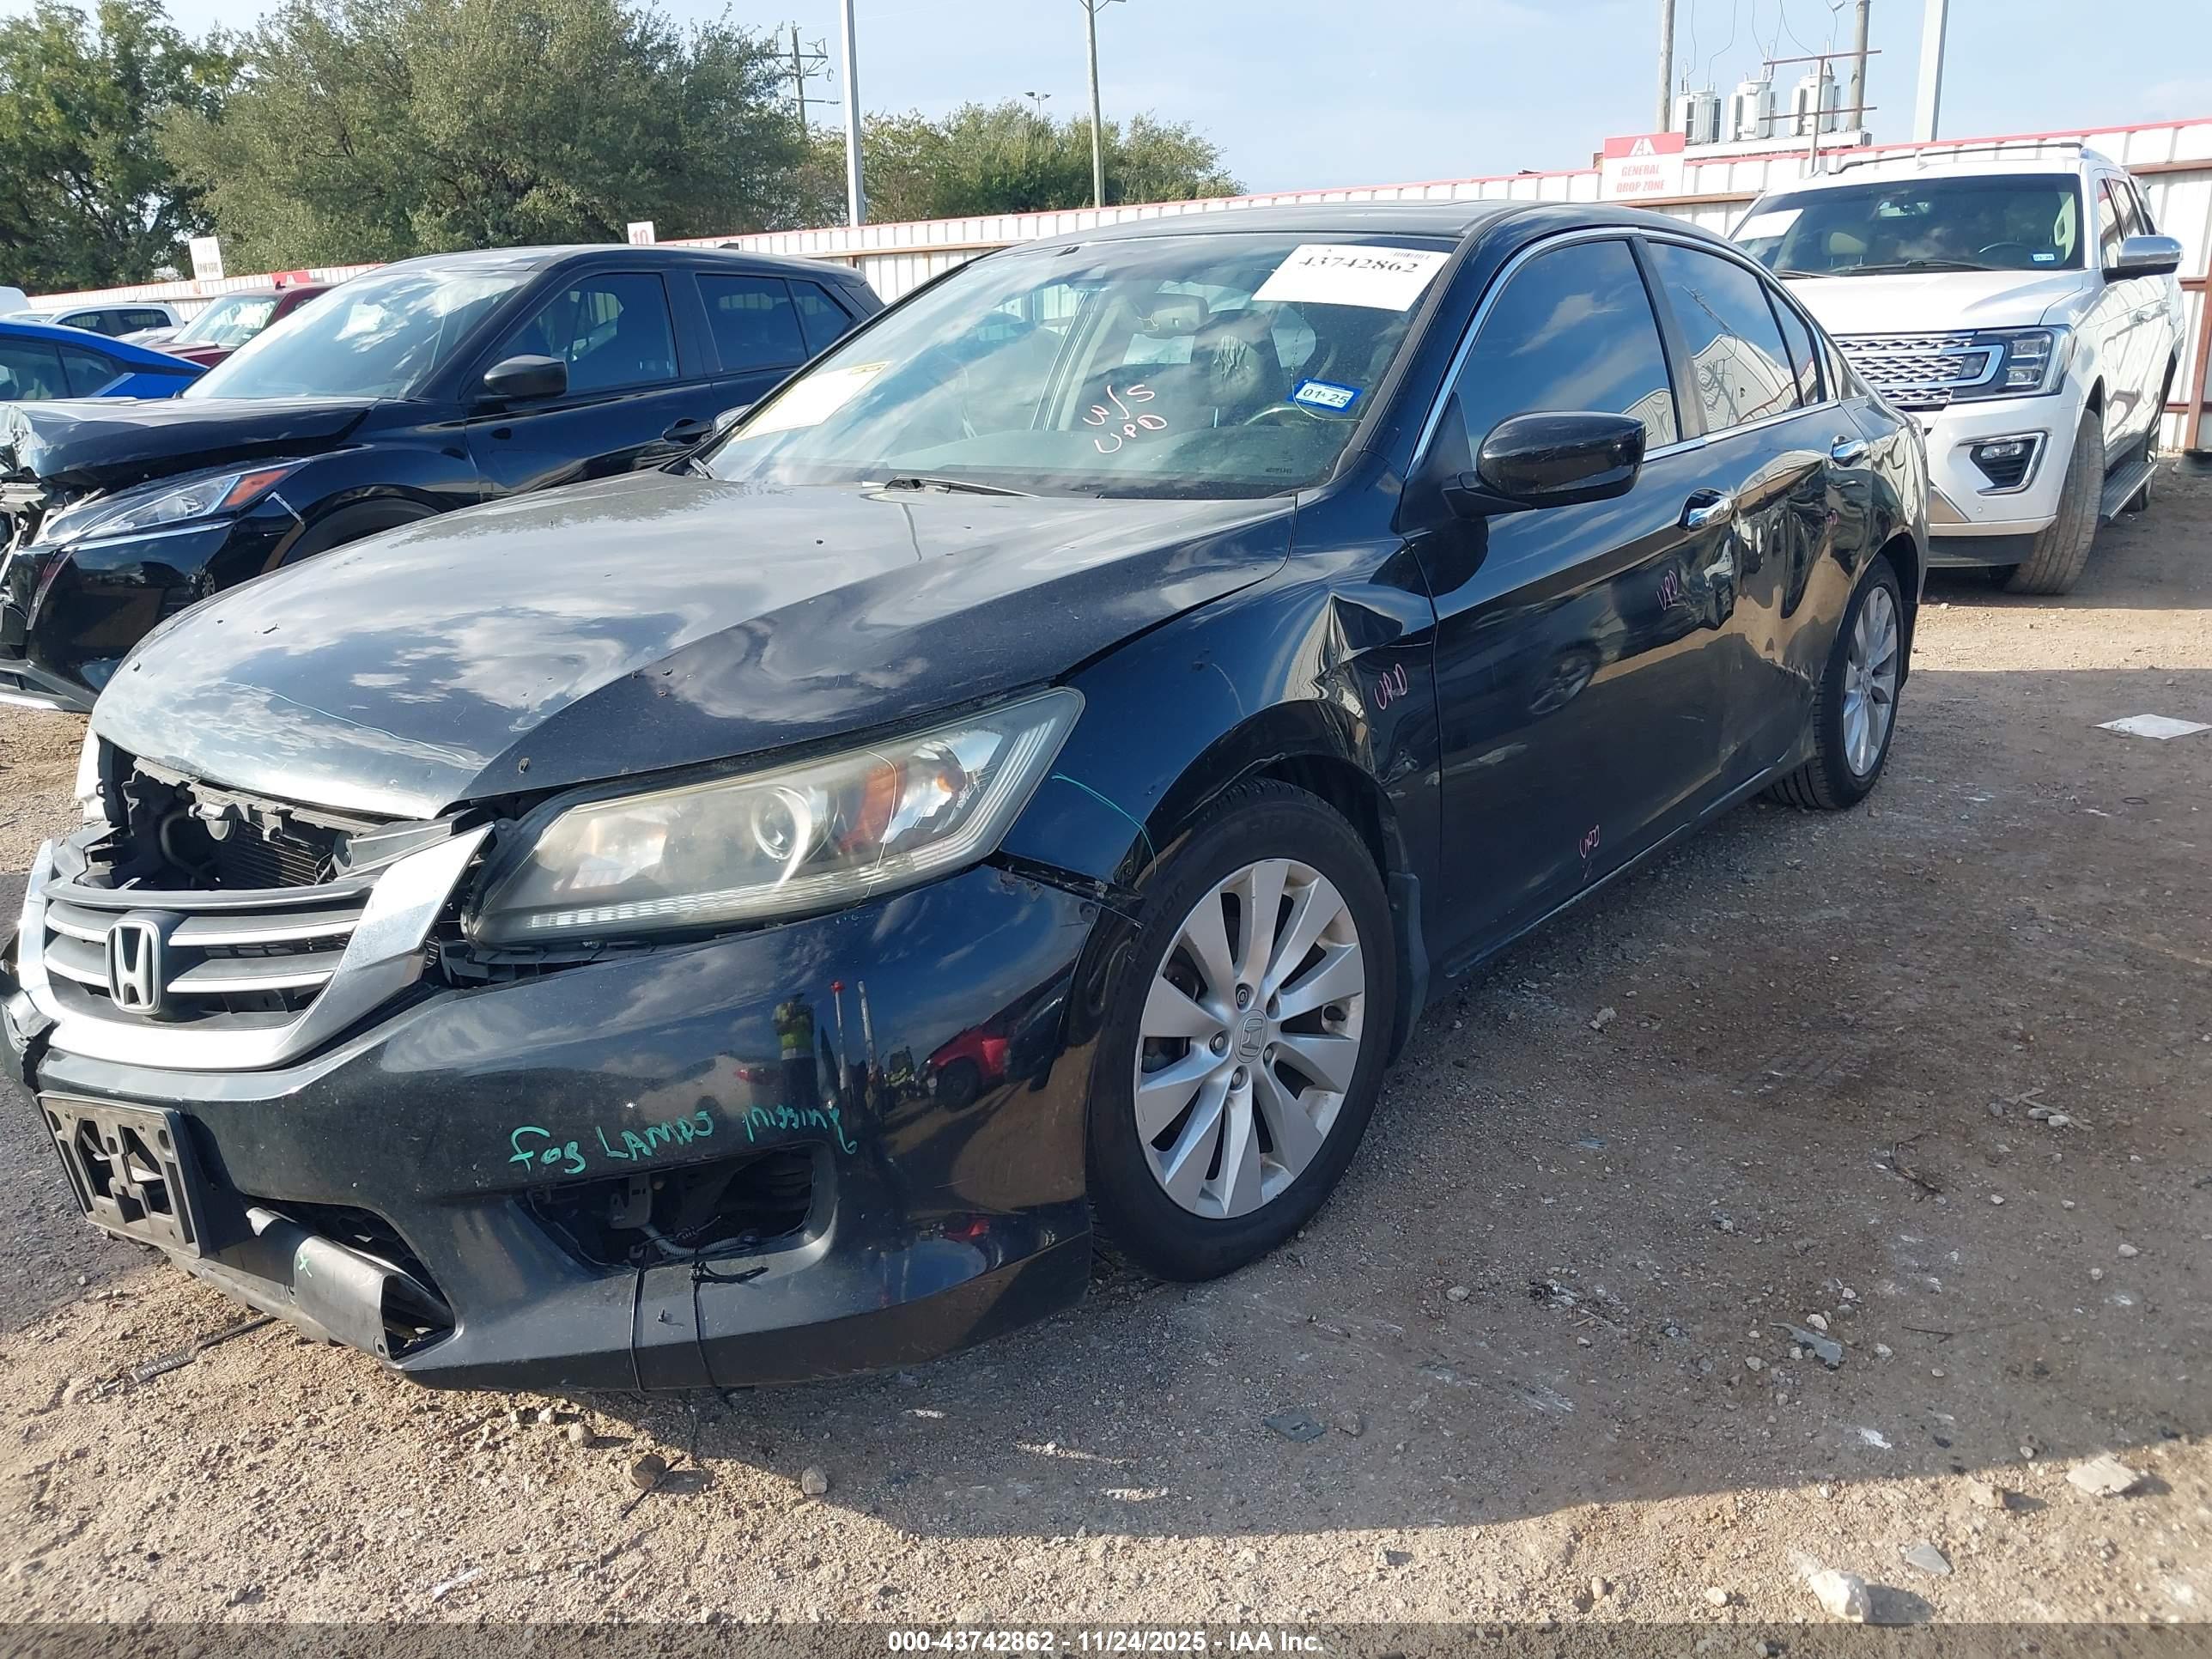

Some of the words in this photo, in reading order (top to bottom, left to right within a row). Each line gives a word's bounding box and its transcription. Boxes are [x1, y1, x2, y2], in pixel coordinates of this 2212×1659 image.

[1621, 164, 1661, 177] GENERAL
[1616, 181, 1641, 193] DROP
[1643, 180, 1665, 192] ZONE
[1298, 255, 1419, 274] 43742862
[1303, 388, 1322, 399] 01
[1327, 392, 1351, 404] 25
